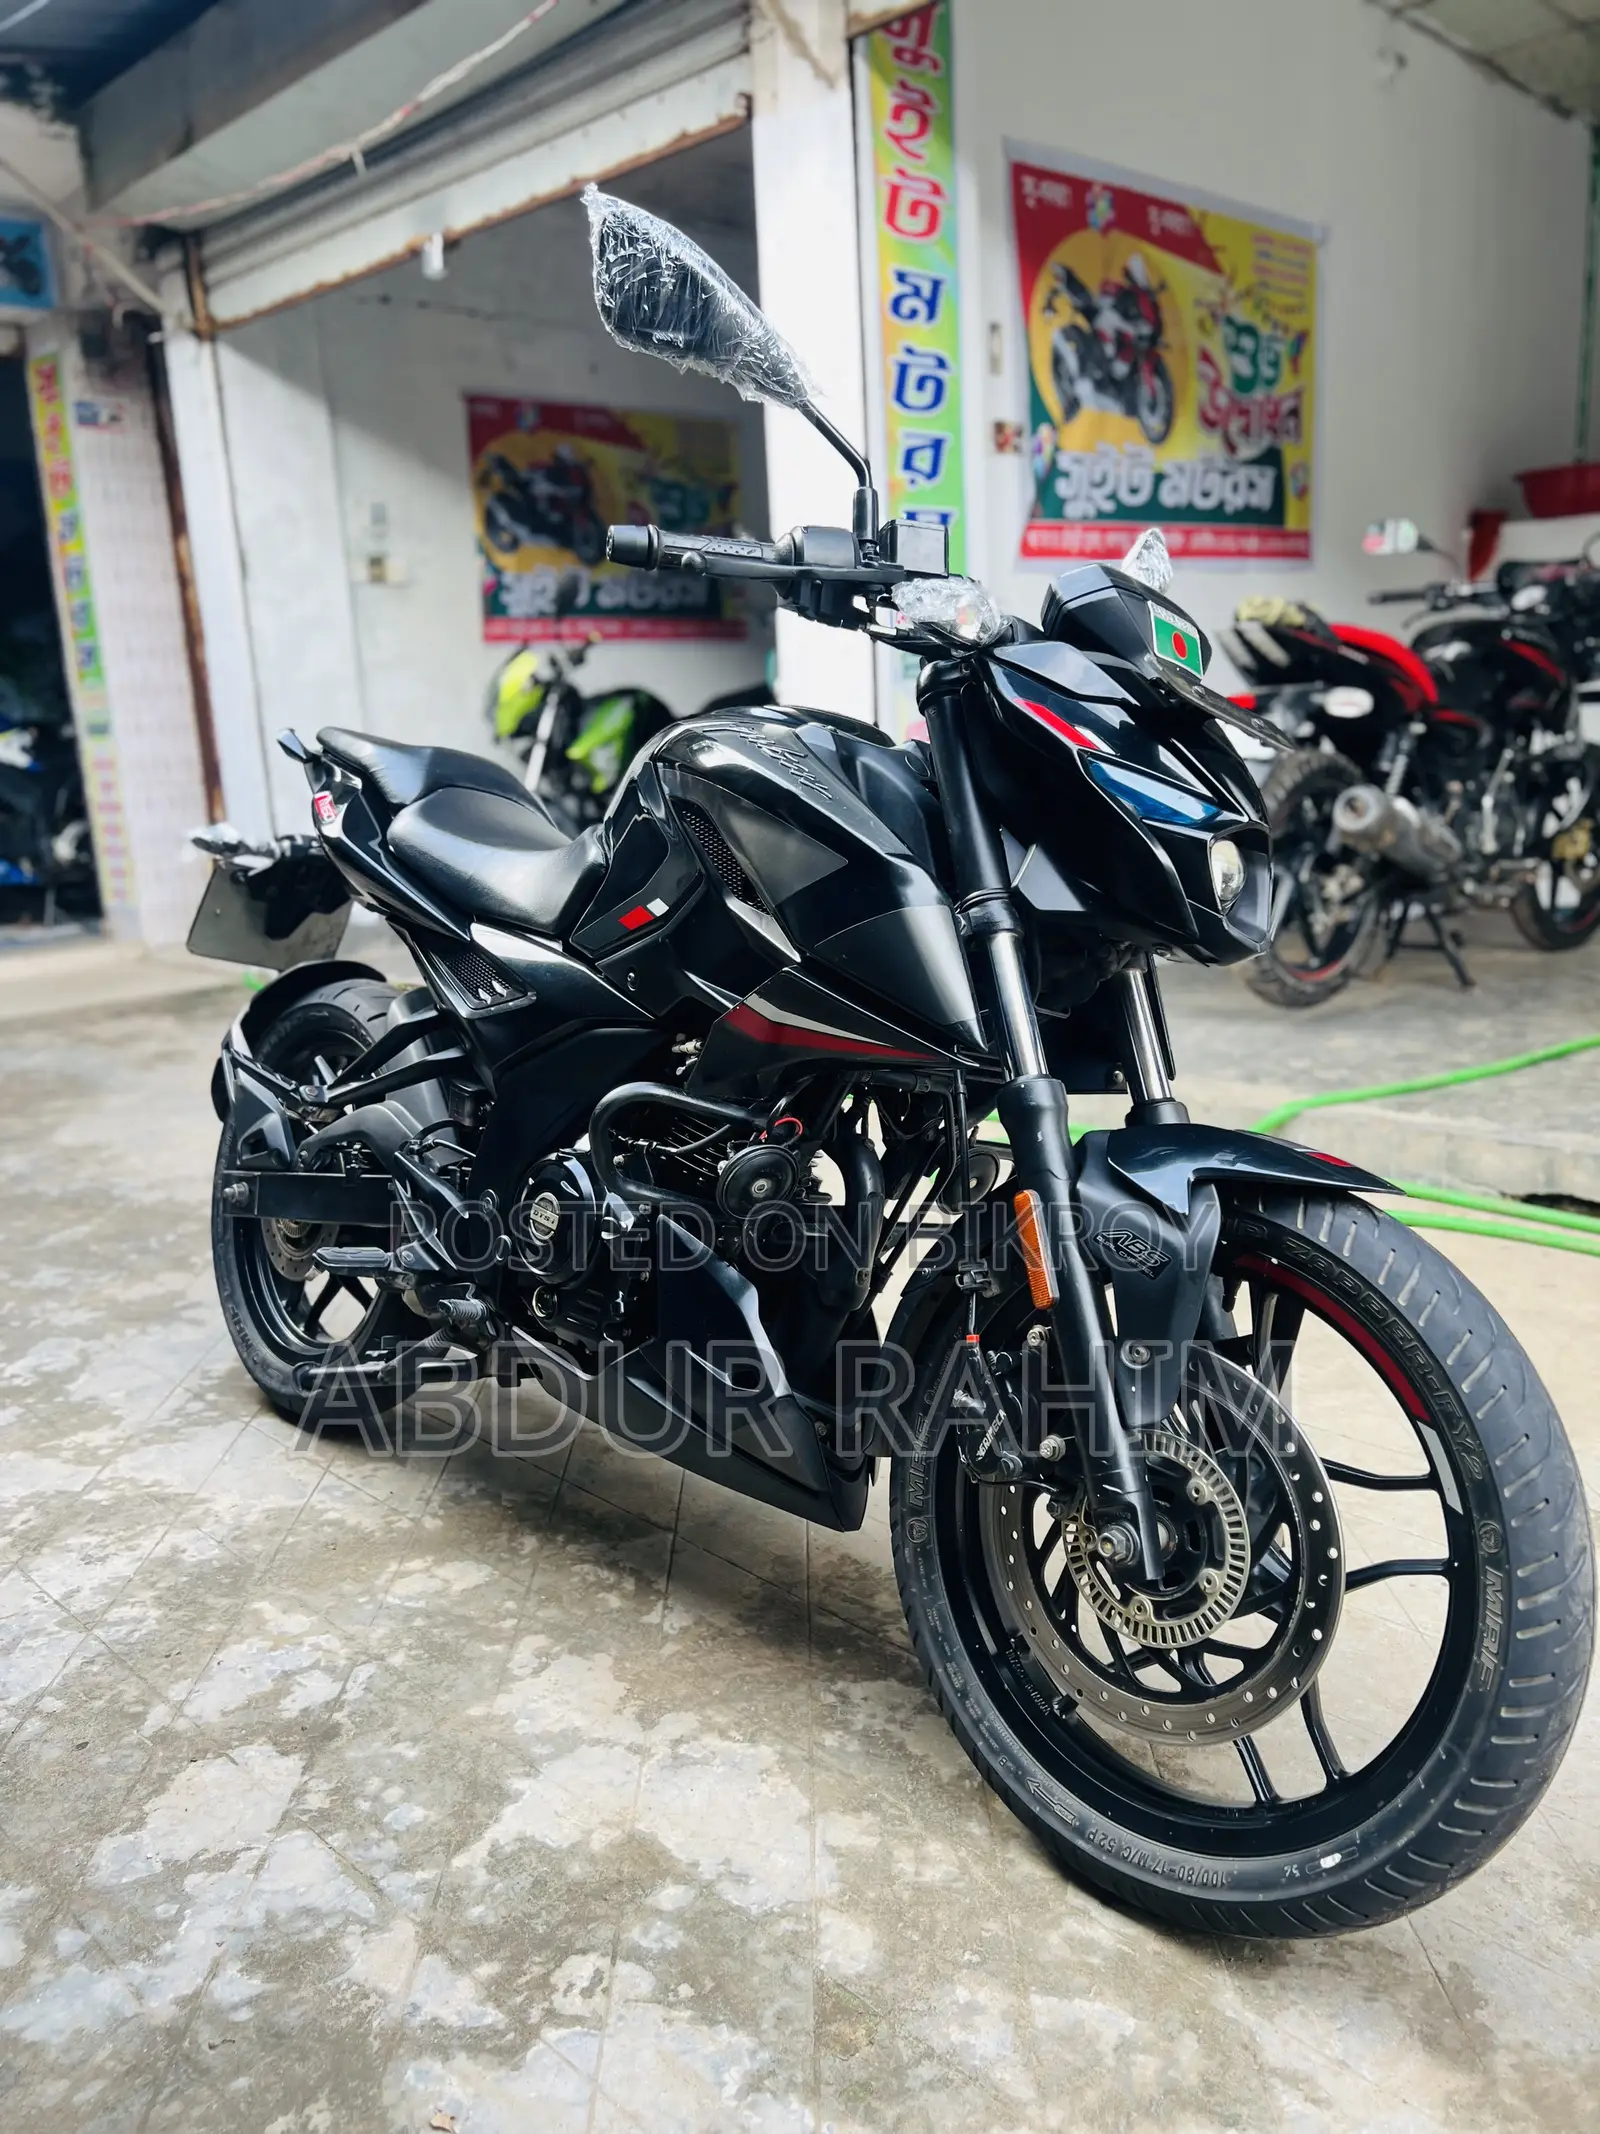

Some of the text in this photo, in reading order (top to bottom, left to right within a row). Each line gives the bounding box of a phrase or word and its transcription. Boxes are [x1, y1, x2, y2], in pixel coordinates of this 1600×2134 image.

[889, 267, 953, 524] মটর
[1055, 443, 1156, 520] সুইট
[1100, 1230, 1172, 1267] ABS
[907, 1412, 931, 1508] MRF
[978, 1409, 1006, 1459] GRIMECA
[1477, 1563, 1506, 1692] MRF
[1119, 1845, 1151, 1870] M/C
[1152, 1857, 1228, 1889] 100/80-17
